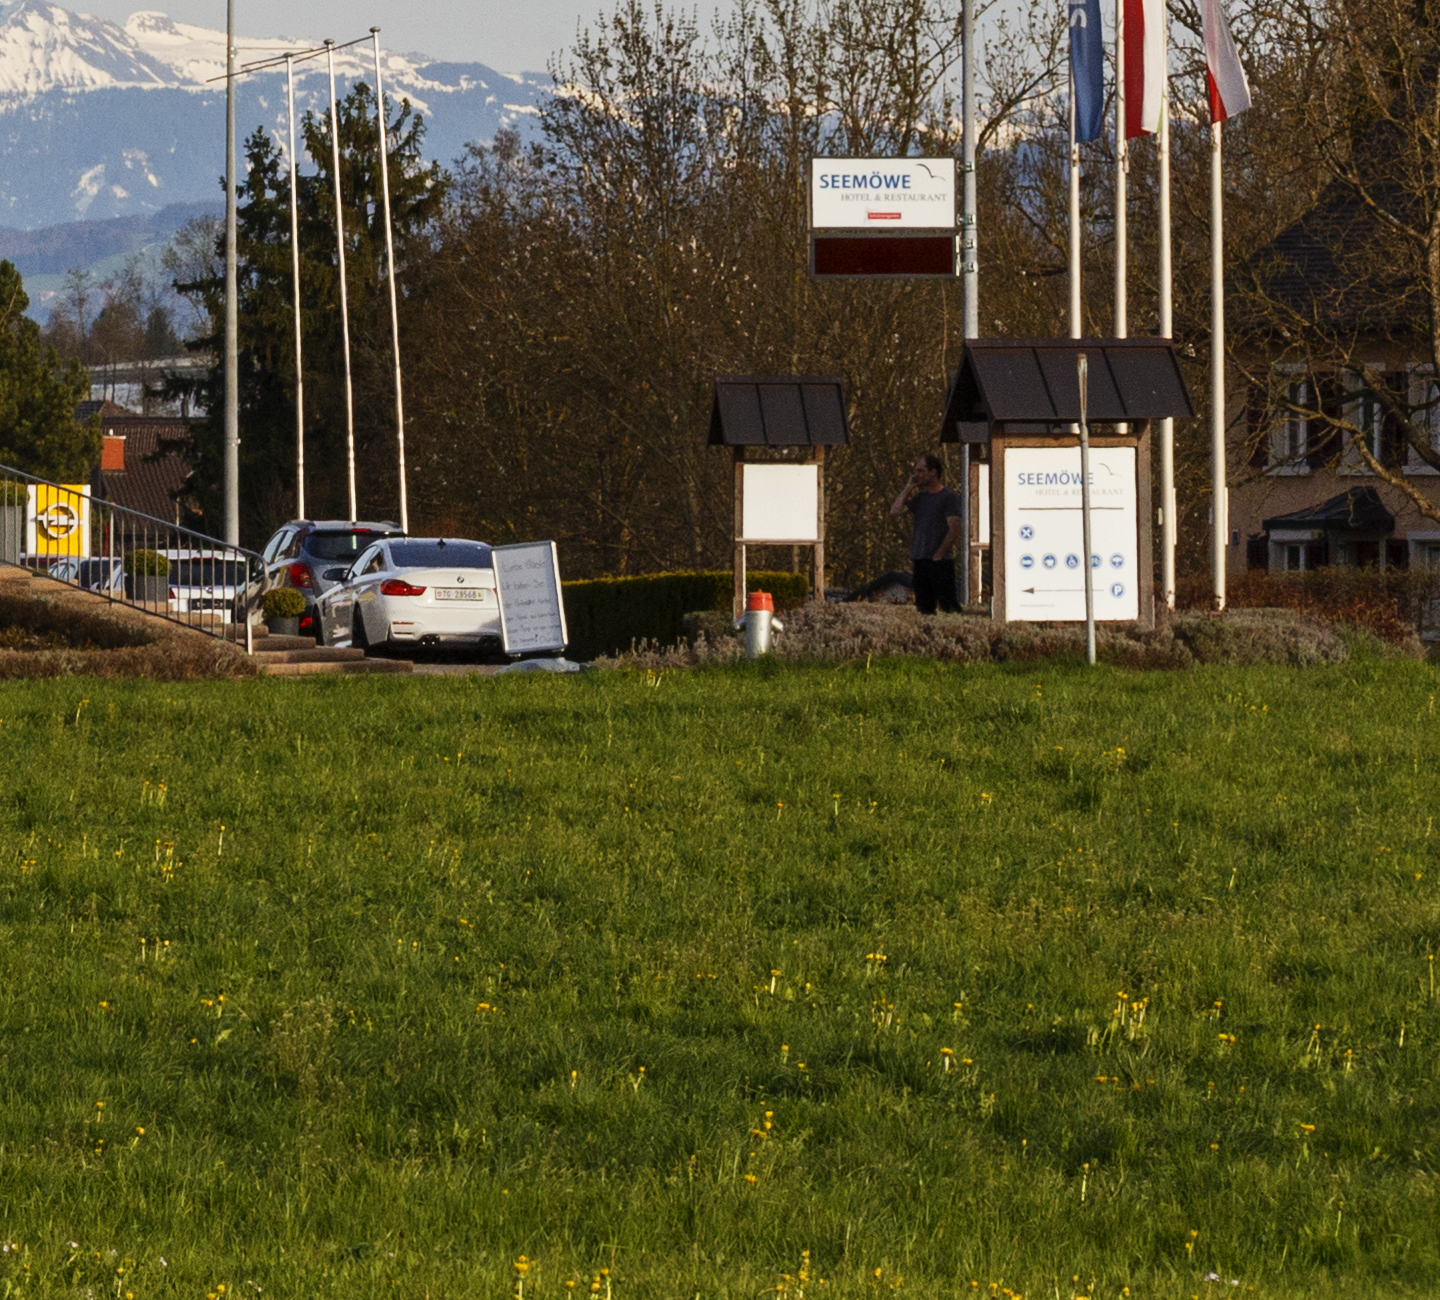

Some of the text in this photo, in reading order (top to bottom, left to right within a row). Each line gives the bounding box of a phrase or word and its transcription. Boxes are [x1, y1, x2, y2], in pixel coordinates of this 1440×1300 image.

[819, 171, 911, 189] SEEMÖWE
[841, 193, 947, 201] HOTEL & RESTAURANT
